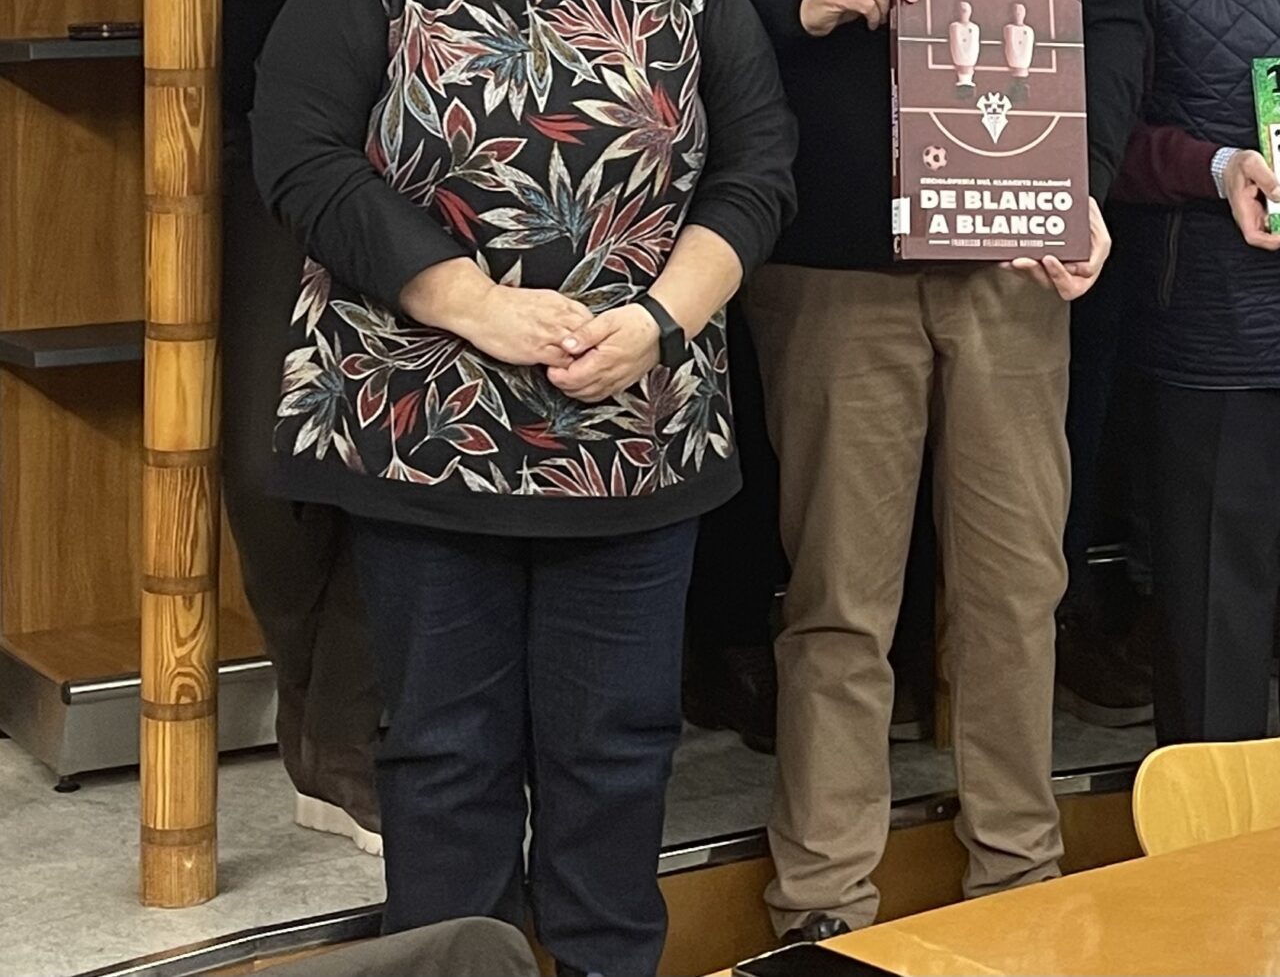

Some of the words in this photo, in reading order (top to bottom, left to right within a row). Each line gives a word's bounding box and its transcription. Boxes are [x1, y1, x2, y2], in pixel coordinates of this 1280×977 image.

[920, 189, 957, 209] DE
[964, 190, 1073, 211] BLANCO
[928, 214, 949, 234] A
[956, 214, 1065, 236] BLANCO
